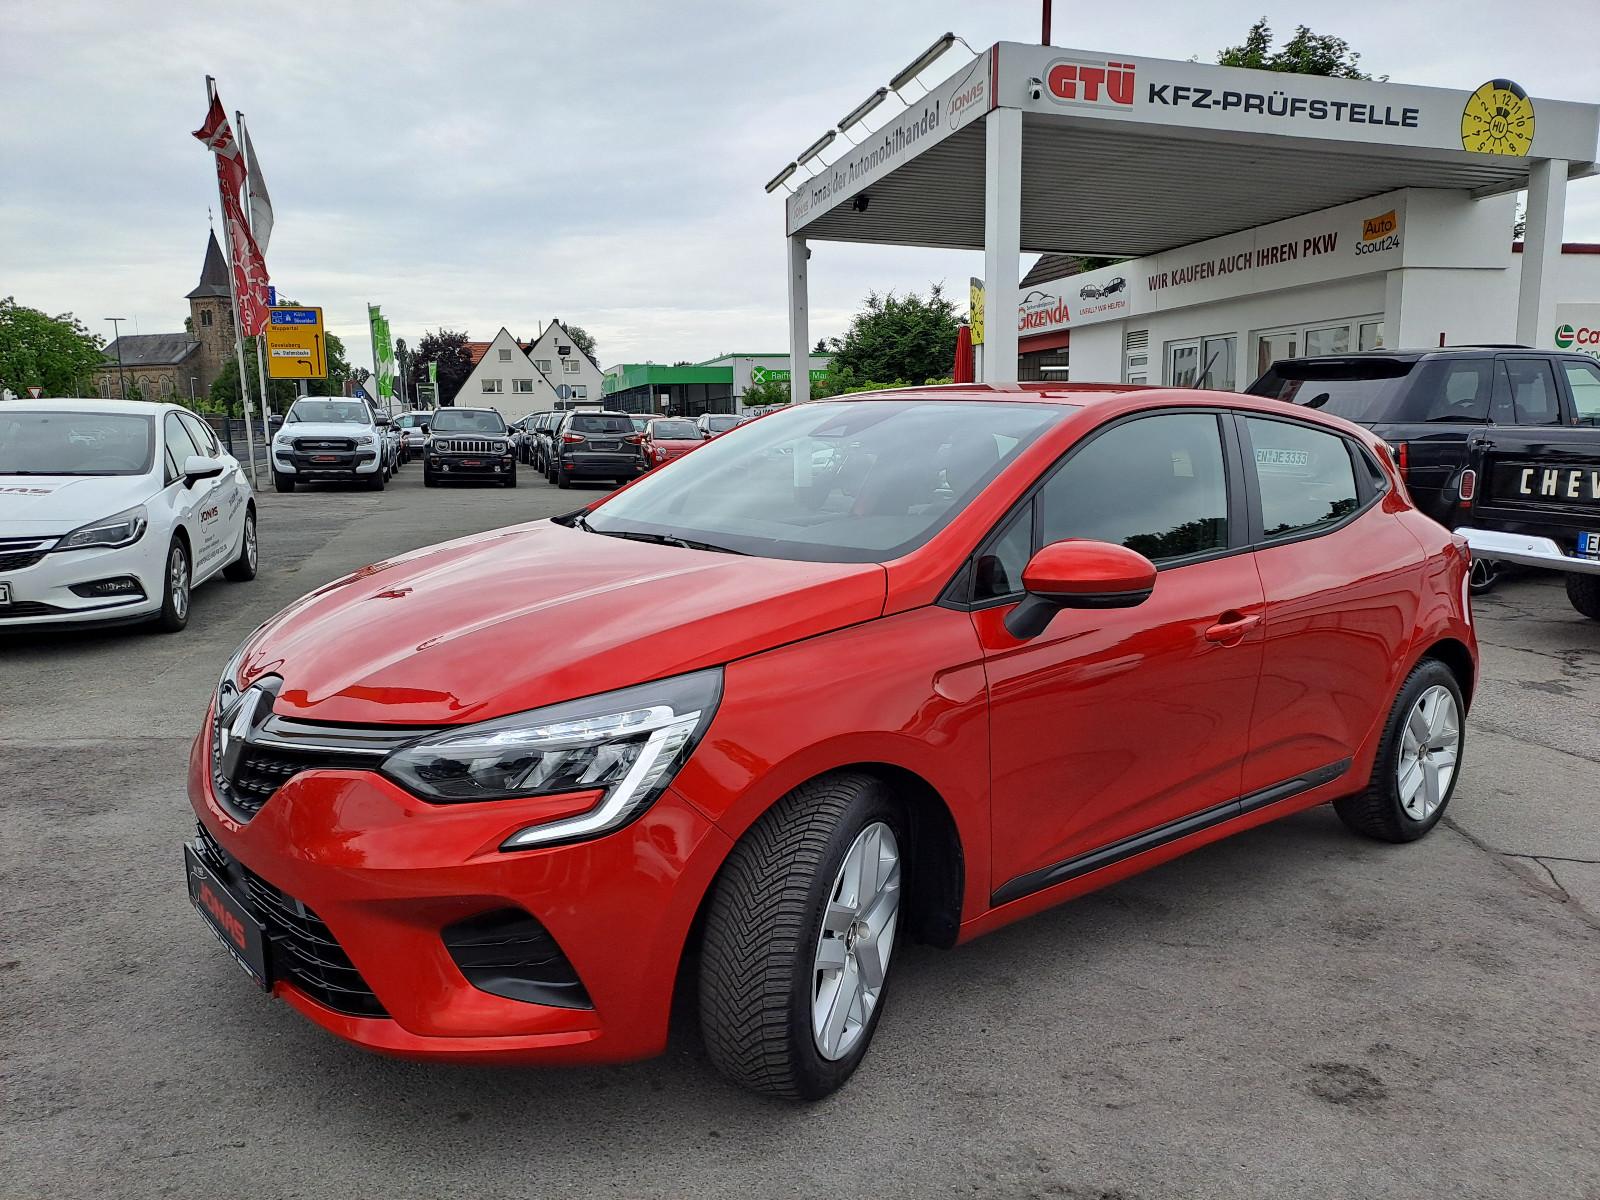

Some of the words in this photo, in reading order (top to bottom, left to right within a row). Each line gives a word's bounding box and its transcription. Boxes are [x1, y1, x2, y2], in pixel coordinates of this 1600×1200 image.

[1048, 62, 1135, 105] GTÜ
[950, 80, 983, 115] JONAS
[1149, 83, 1419, 127] KFZ-PRÜFSTELLE
[1503, 93, 1512, 106] 12
[1480, 101, 1489, 112] 2
[1492, 120, 1505, 134] HU
[1515, 115, 1526, 128] 10
[810, 182, 831, 209] Jonas
[833, 171, 847, 194] der
[848, 99, 940, 185] Automobilhandel
[1509, 142, 1517, 152] 8
[1365, 220, 1393, 236] Auto
[1355, 234, 1400, 256] Scout24
[1148, 272, 1168, 292] WIR
[1171, 260, 1215, 287] KAUFEN
[1218, 251, 1253, 275] AUCH
[1256, 241, 1298, 267] IHREN
[1303, 231, 1338, 258] PKW
[771, 372, 791, 380] Raiff
